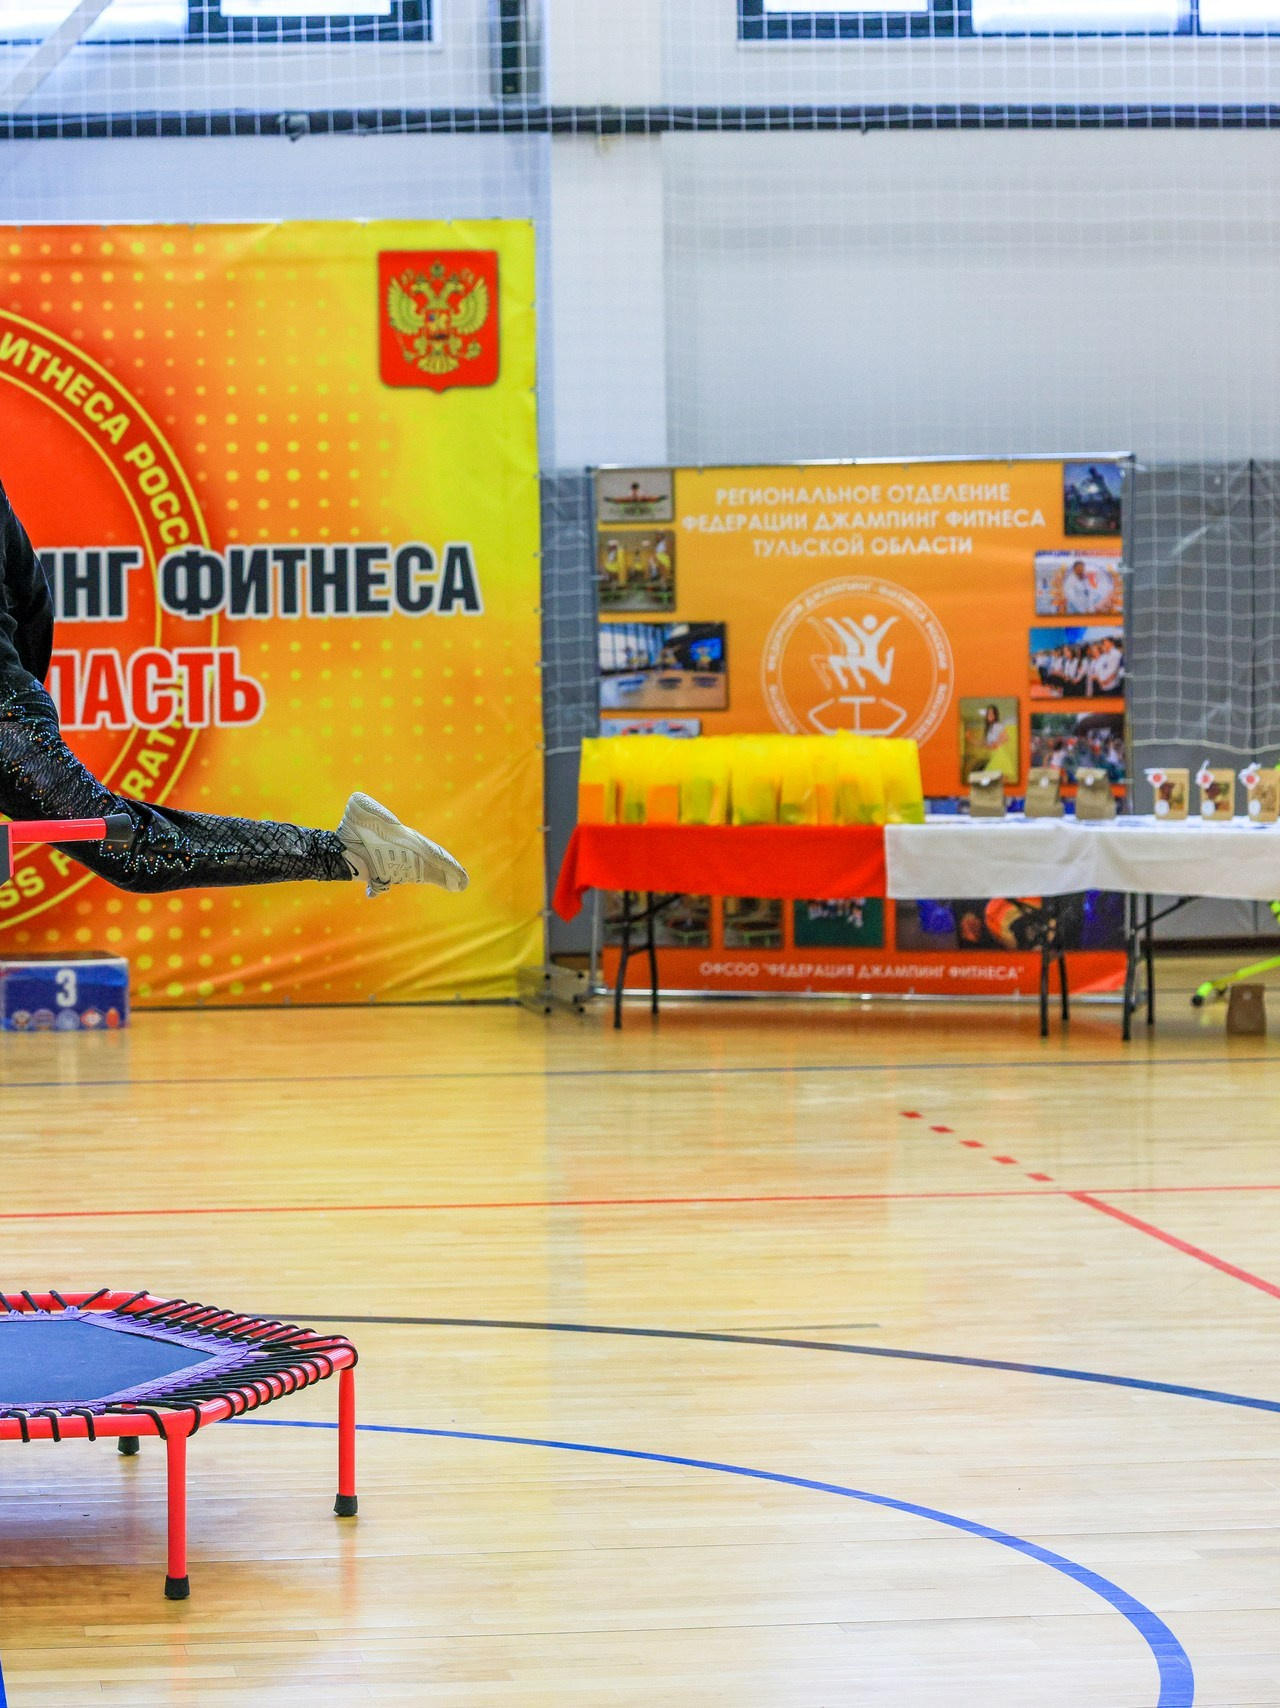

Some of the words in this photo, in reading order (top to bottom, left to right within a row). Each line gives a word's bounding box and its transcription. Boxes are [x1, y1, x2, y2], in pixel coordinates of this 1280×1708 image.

[123, 442, 191, 554] РОСС
[716, 485, 880, 506] РЕГИОНАЛЬНОЕ
[886, 483, 1010, 505] ОТДЕЛЕНИЕ
[682, 513, 808, 533] ФЕДЕРАЦИИ
[813, 510, 939, 532] ДЖАМПИНГ
[945, 509, 1046, 529] ФИТНЕСА
[754, 534, 865, 558] ТУЛЬСКОЙ
[870, 536, 973, 556] ОБЛАСТИ
[159, 543, 483, 620] ФИТНЕСА
[857, 963, 945, 980] ДЖАМПИНГ
[55, 969, 77, 1007] 3
